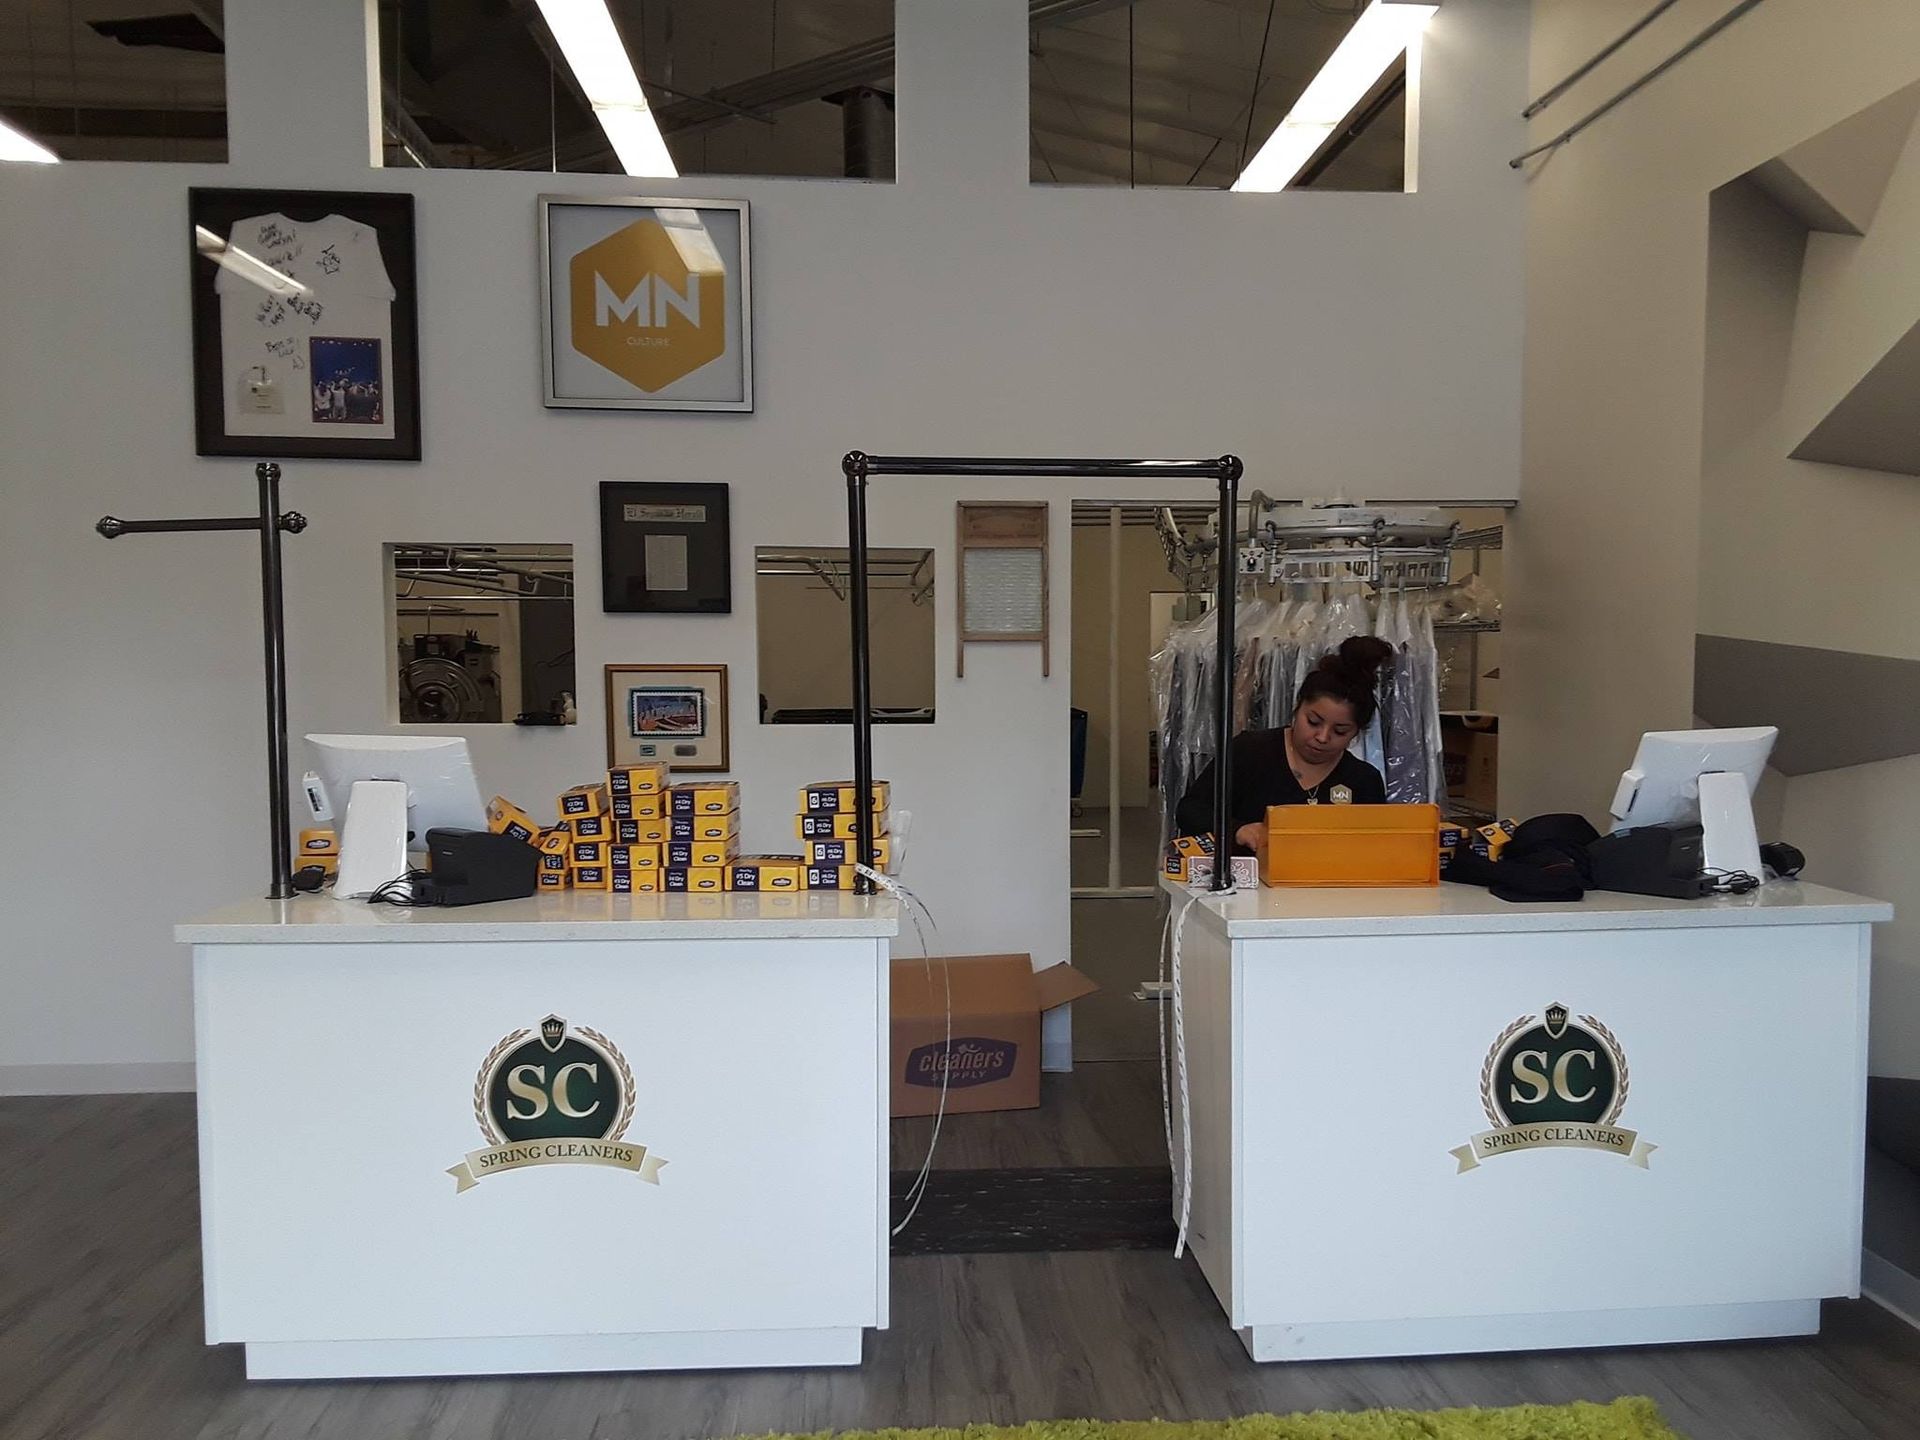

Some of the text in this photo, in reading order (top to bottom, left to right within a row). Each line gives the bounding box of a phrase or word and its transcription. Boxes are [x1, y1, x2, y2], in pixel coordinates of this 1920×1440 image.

[594, 269, 700, 329] MN
[626, 336, 671, 347] CULTURE
[744, 872, 756, 880] Dry
[918, 1049, 1005, 1073] cleaners
[1510, 1049, 1596, 1104] SC
[506, 1062, 600, 1120] SC
[1483, 1127, 1625, 1149] SPRING CLEANERS
[479, 1144, 632, 1168] SPRING CLEANERS
